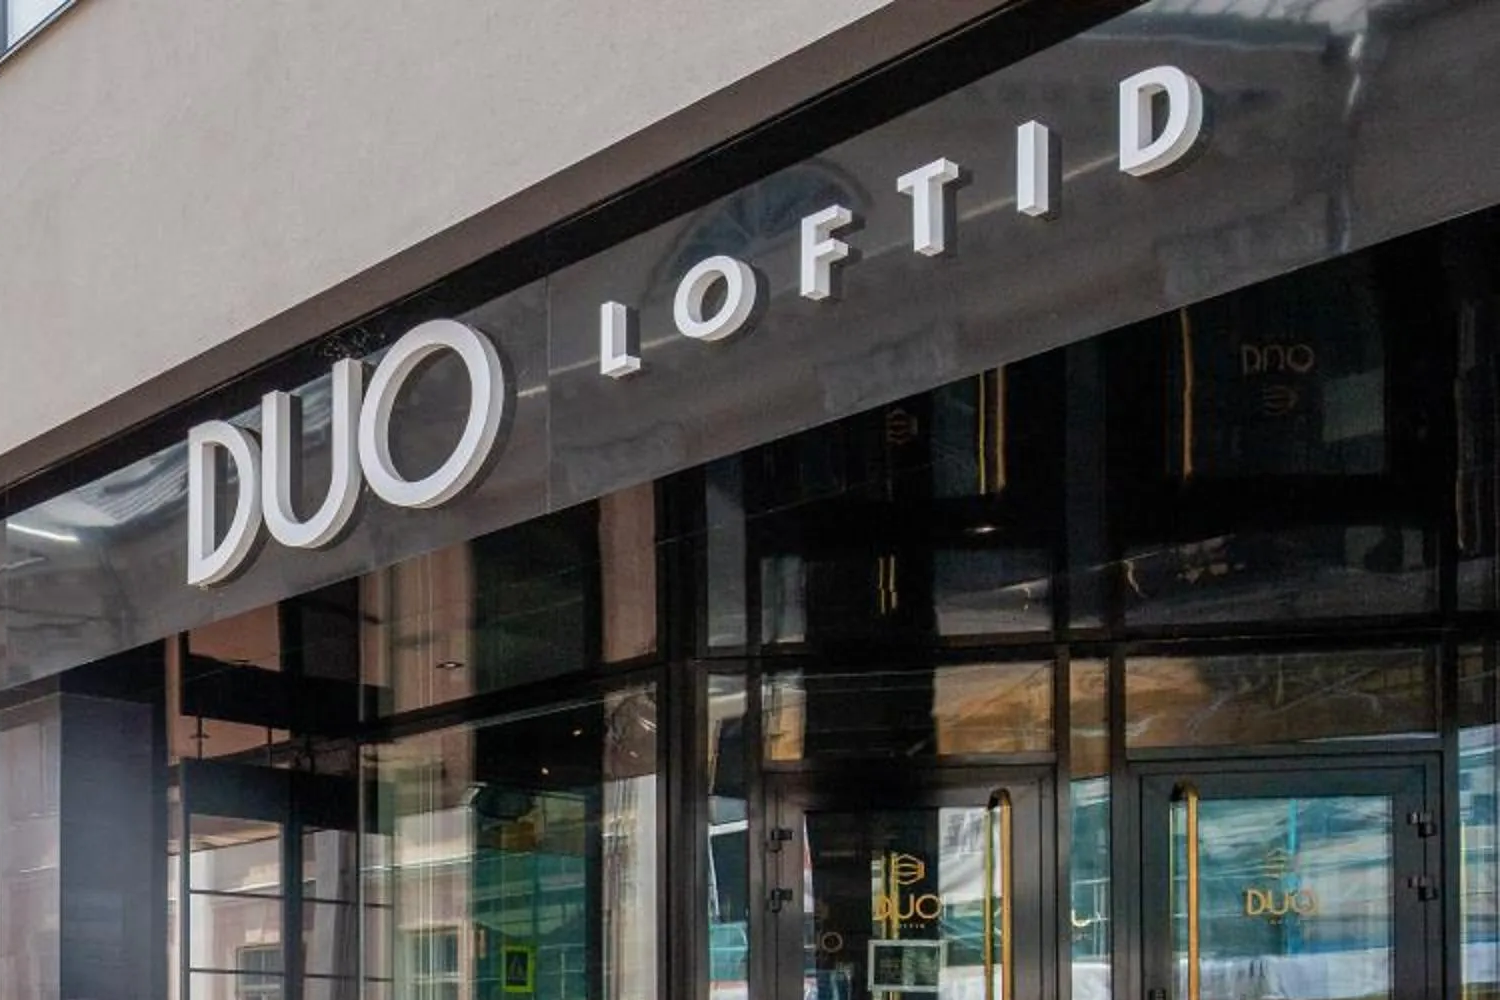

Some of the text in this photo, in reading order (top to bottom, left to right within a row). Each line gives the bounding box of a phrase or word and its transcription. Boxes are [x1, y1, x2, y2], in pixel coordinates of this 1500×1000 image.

[187, 64, 1204, 588] DUO LOFTID
[873, 893, 943, 920] DUO
[1246, 888, 1318, 915] DUO
